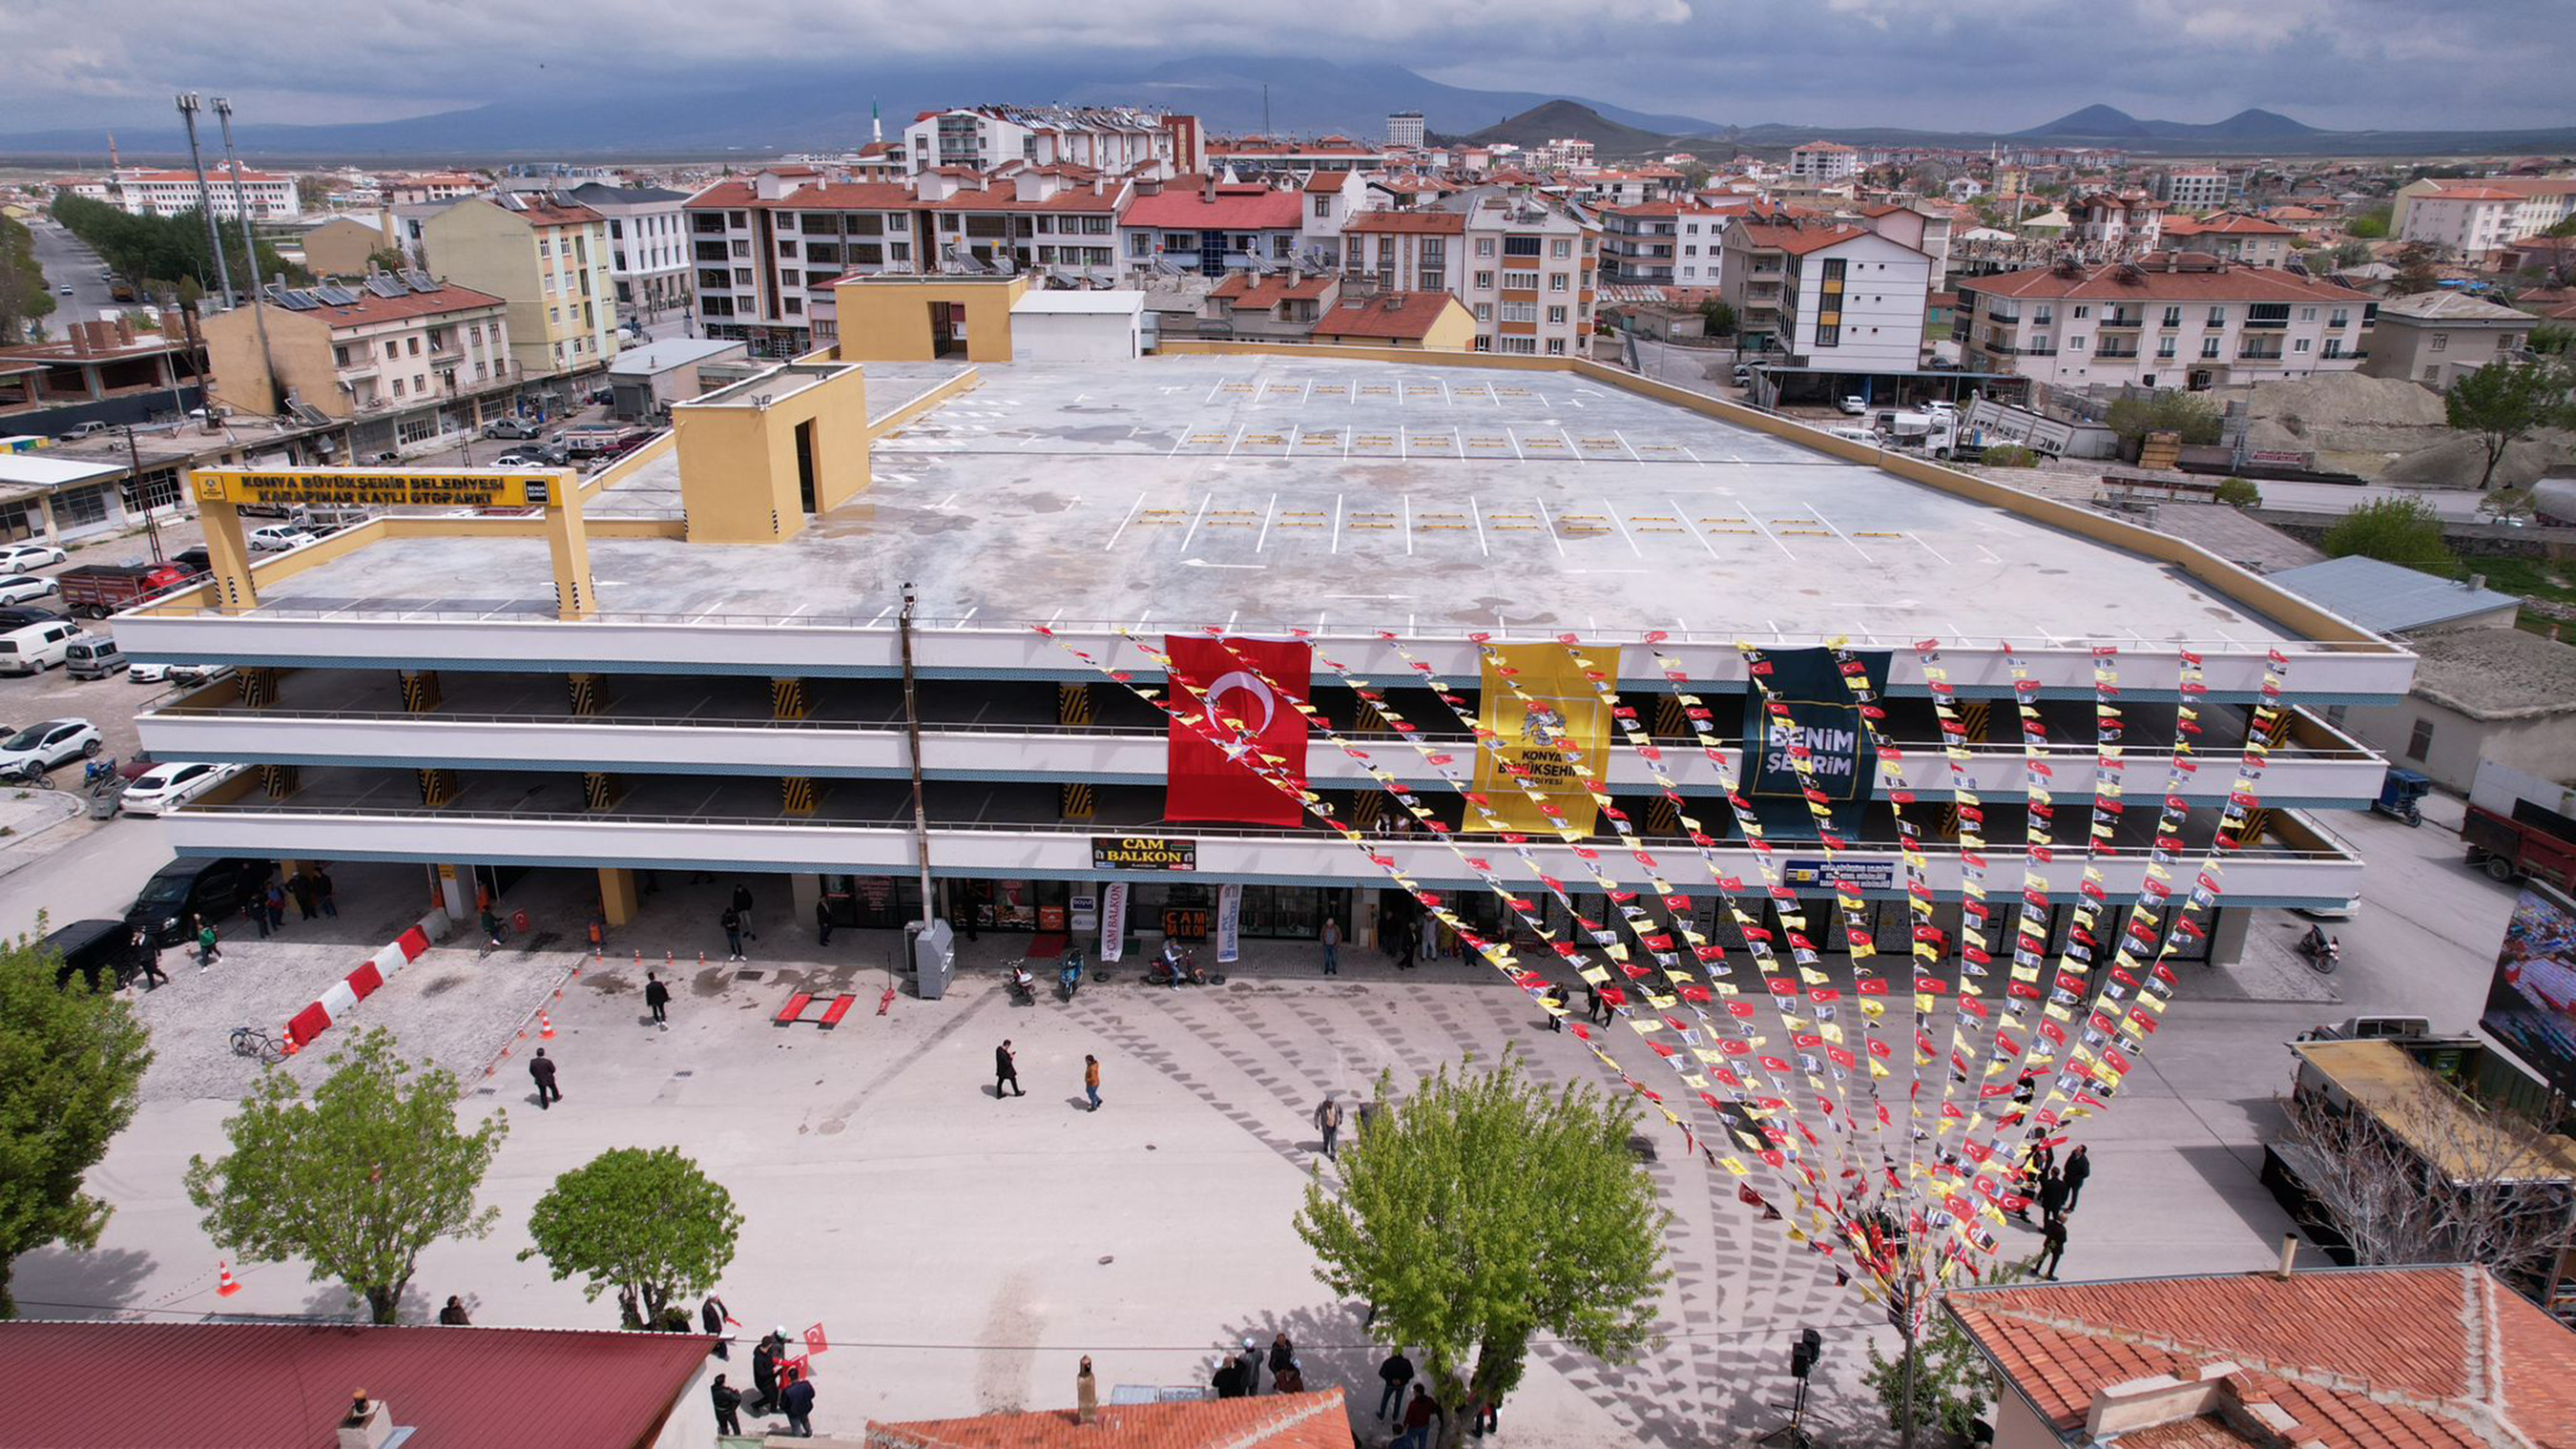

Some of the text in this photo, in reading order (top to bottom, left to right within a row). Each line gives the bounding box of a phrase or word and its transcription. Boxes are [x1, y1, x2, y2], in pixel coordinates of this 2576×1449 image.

[241, 475, 505, 491] KONYA BÜYÜKŞEHİR BELEDİYESİ
[259, 490, 492, 505] KARAPINAR KATLI OTOPARKI
[1522, 750, 1563, 762] KONYA
[1766, 752, 1853, 776] ŞERİM
[1122, 838, 1165, 850] CAM
[1107, 850, 1182, 862] BALKON
[1107, 884, 1122, 951] CAM BALKON
